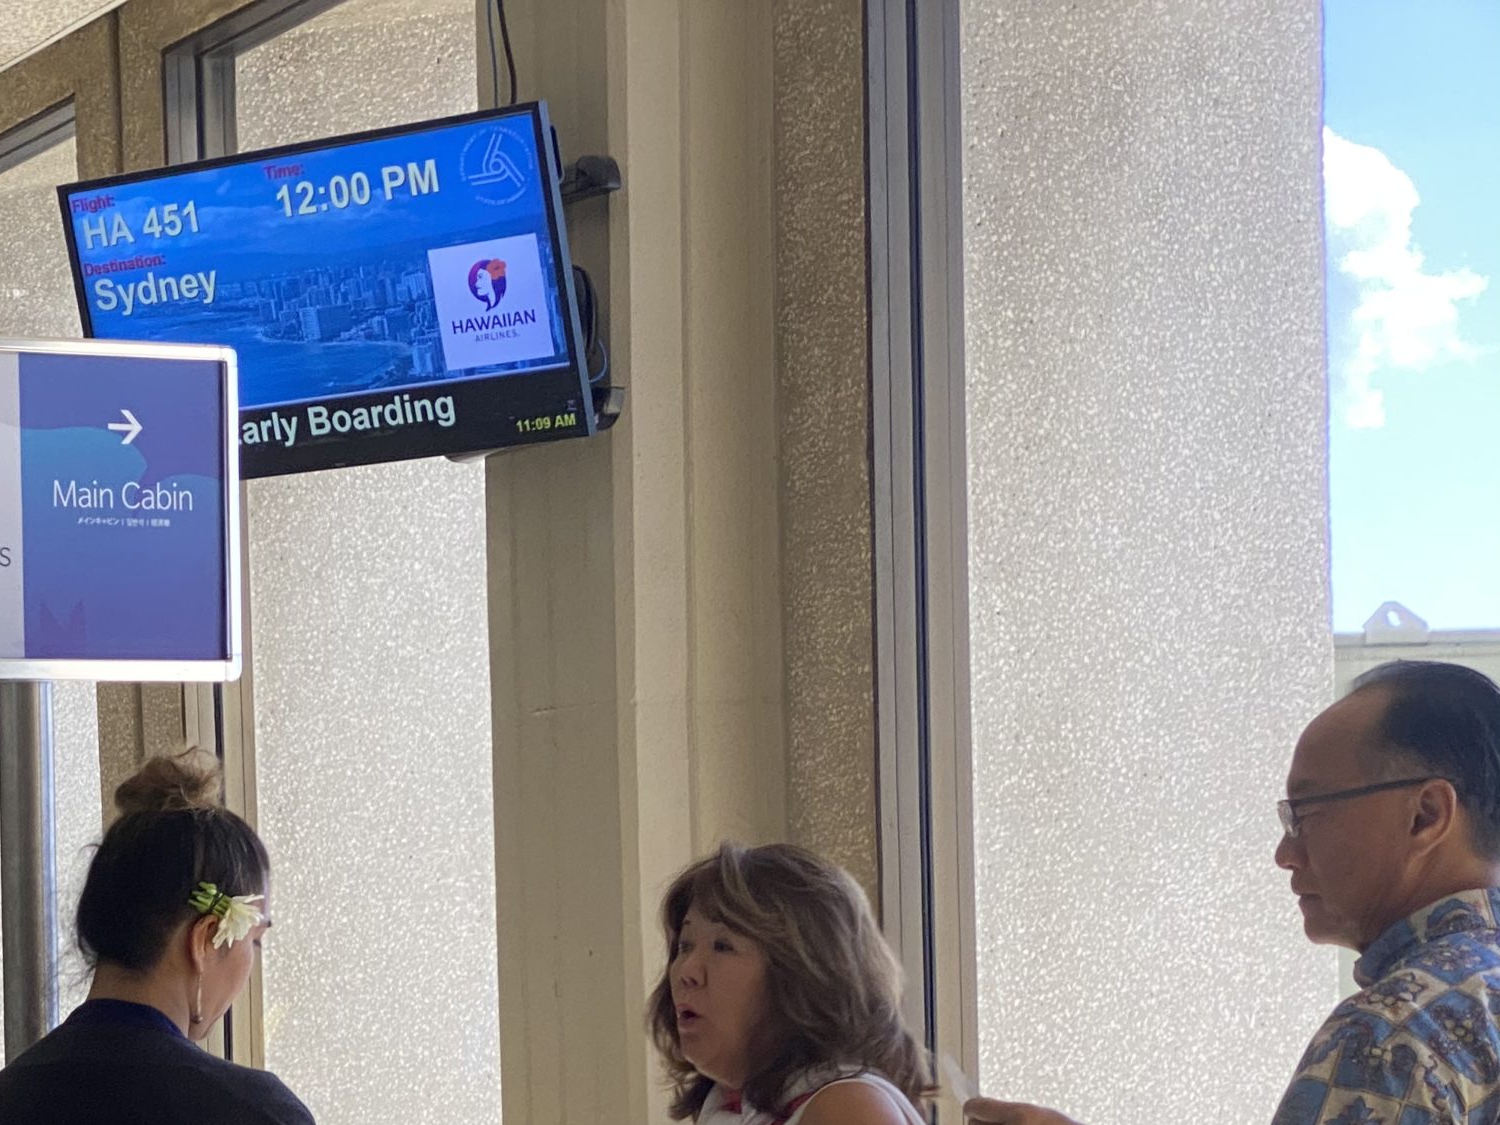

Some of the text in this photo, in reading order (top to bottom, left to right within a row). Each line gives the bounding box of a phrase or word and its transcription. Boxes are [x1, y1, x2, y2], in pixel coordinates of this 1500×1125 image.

[264, 164, 305, 180] Time:
[276, 171, 371, 218] 12:00
[381, 158, 440, 200] PM
[72, 195, 116, 213] Flight:
[83, 200, 199, 250] HA 451
[84, 254, 167, 277] Destination:
[94, 270, 217, 317] Sydney
[451, 308, 536, 335] HAWAIIAN
[237, 394, 456, 447] arly Boarding
[515, 412, 577, 433] 11:09 AM
[53, 478, 194, 511] Main Cabin
